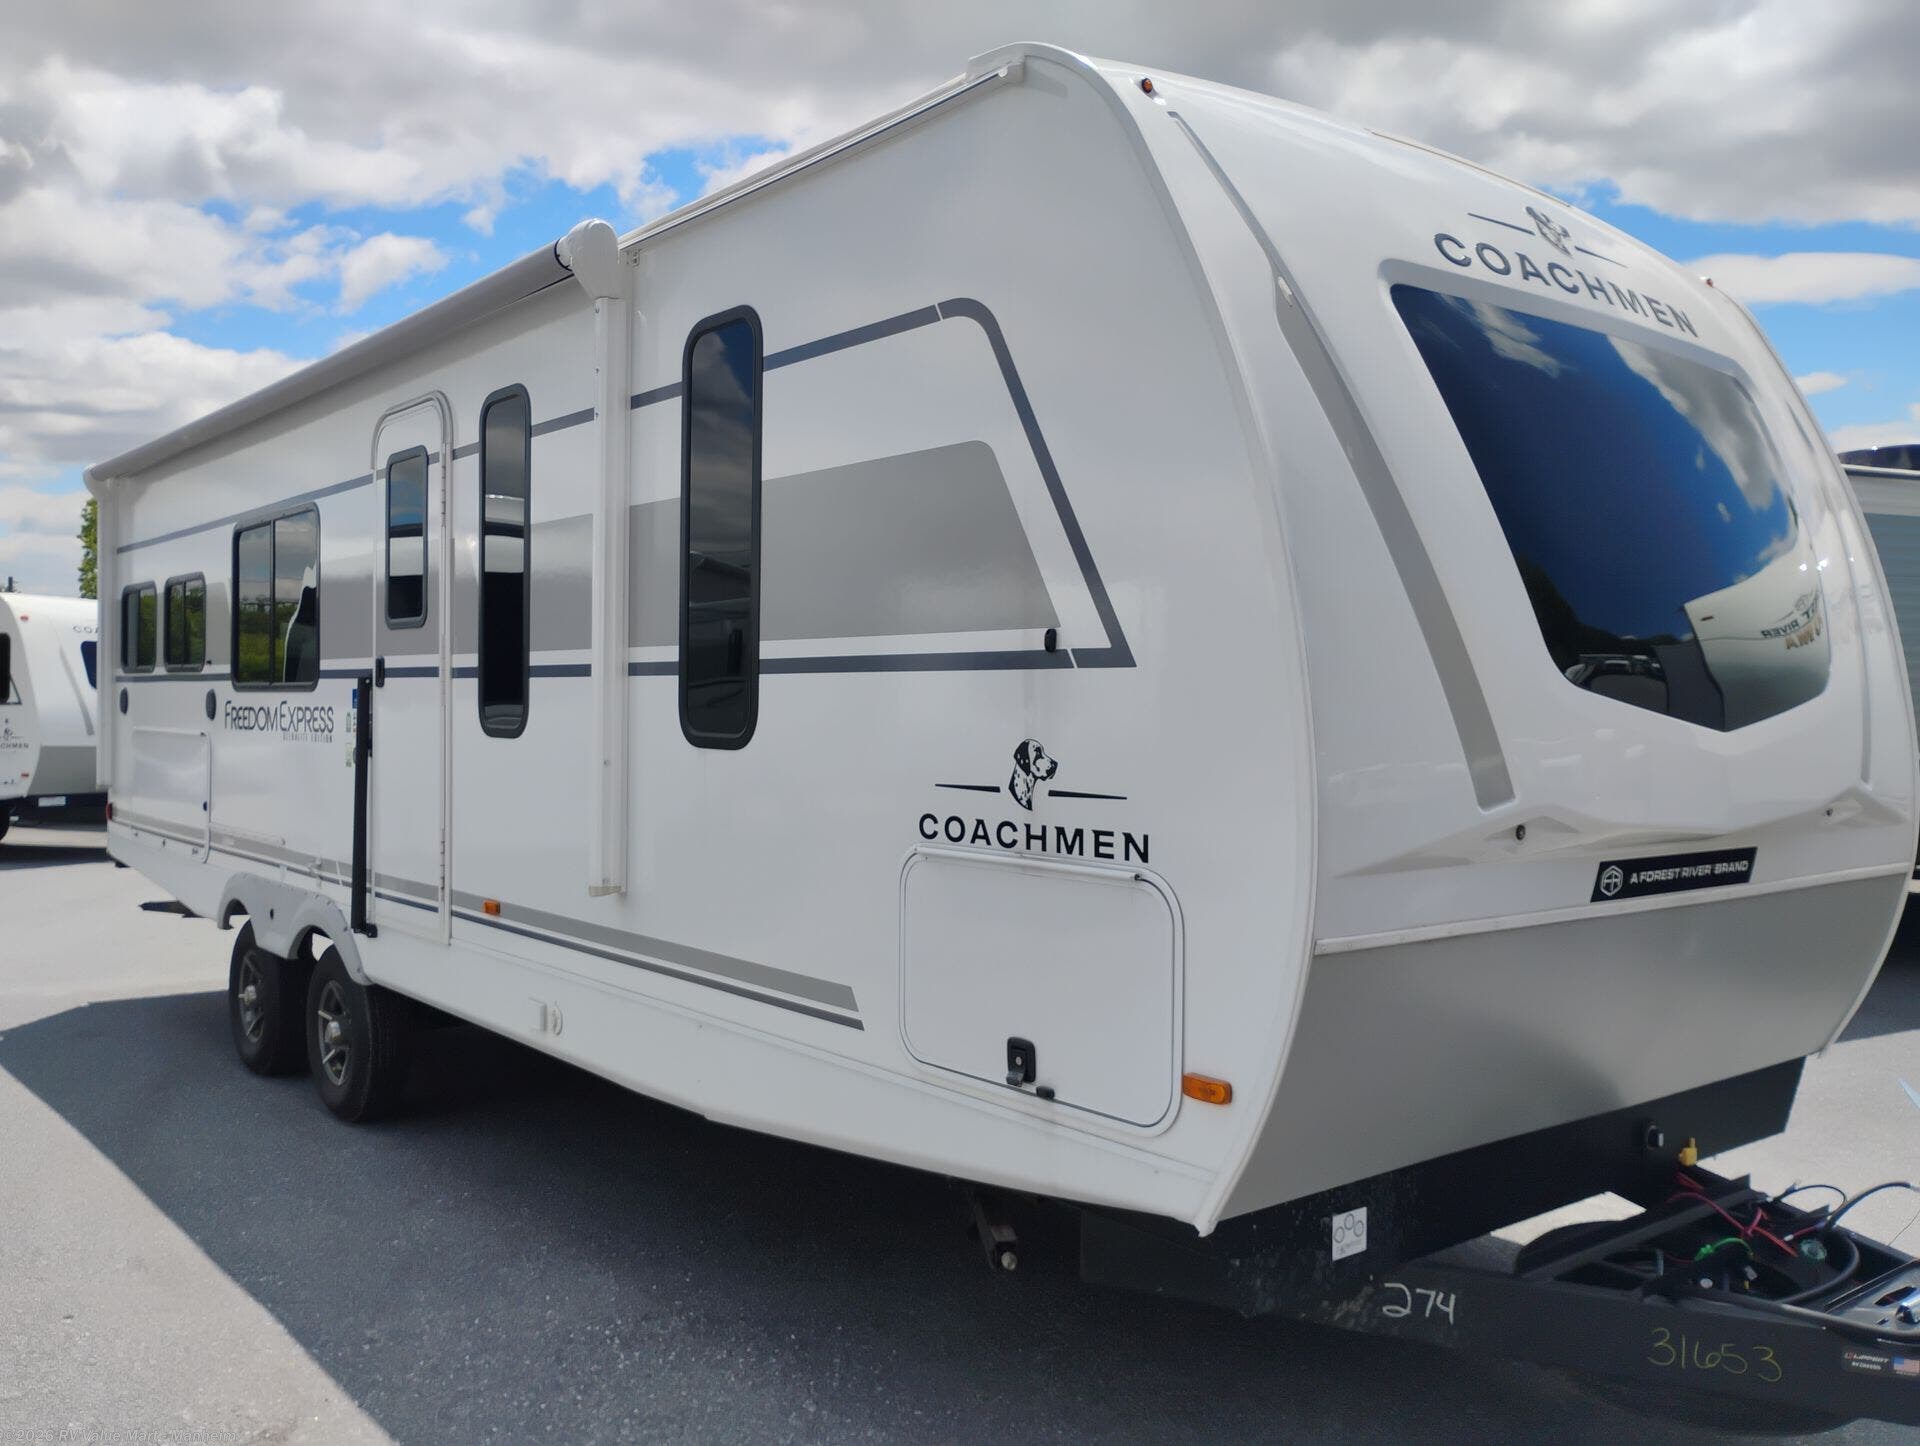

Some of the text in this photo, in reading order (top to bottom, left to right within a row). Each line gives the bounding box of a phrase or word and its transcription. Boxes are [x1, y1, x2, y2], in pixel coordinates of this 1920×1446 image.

[1434, 233, 1698, 338] COACHMEN
[224, 700, 278, 732] FREEDOM
[279, 700, 334, 734] EXPRESS
[918, 812, 1150, 864] COACHMEN
[1629, 861, 1748, 885] A FOREST RIVER BRAND
[1382, 1283, 1456, 1325] 274
[1646, 1327, 1783, 1382] 31653
